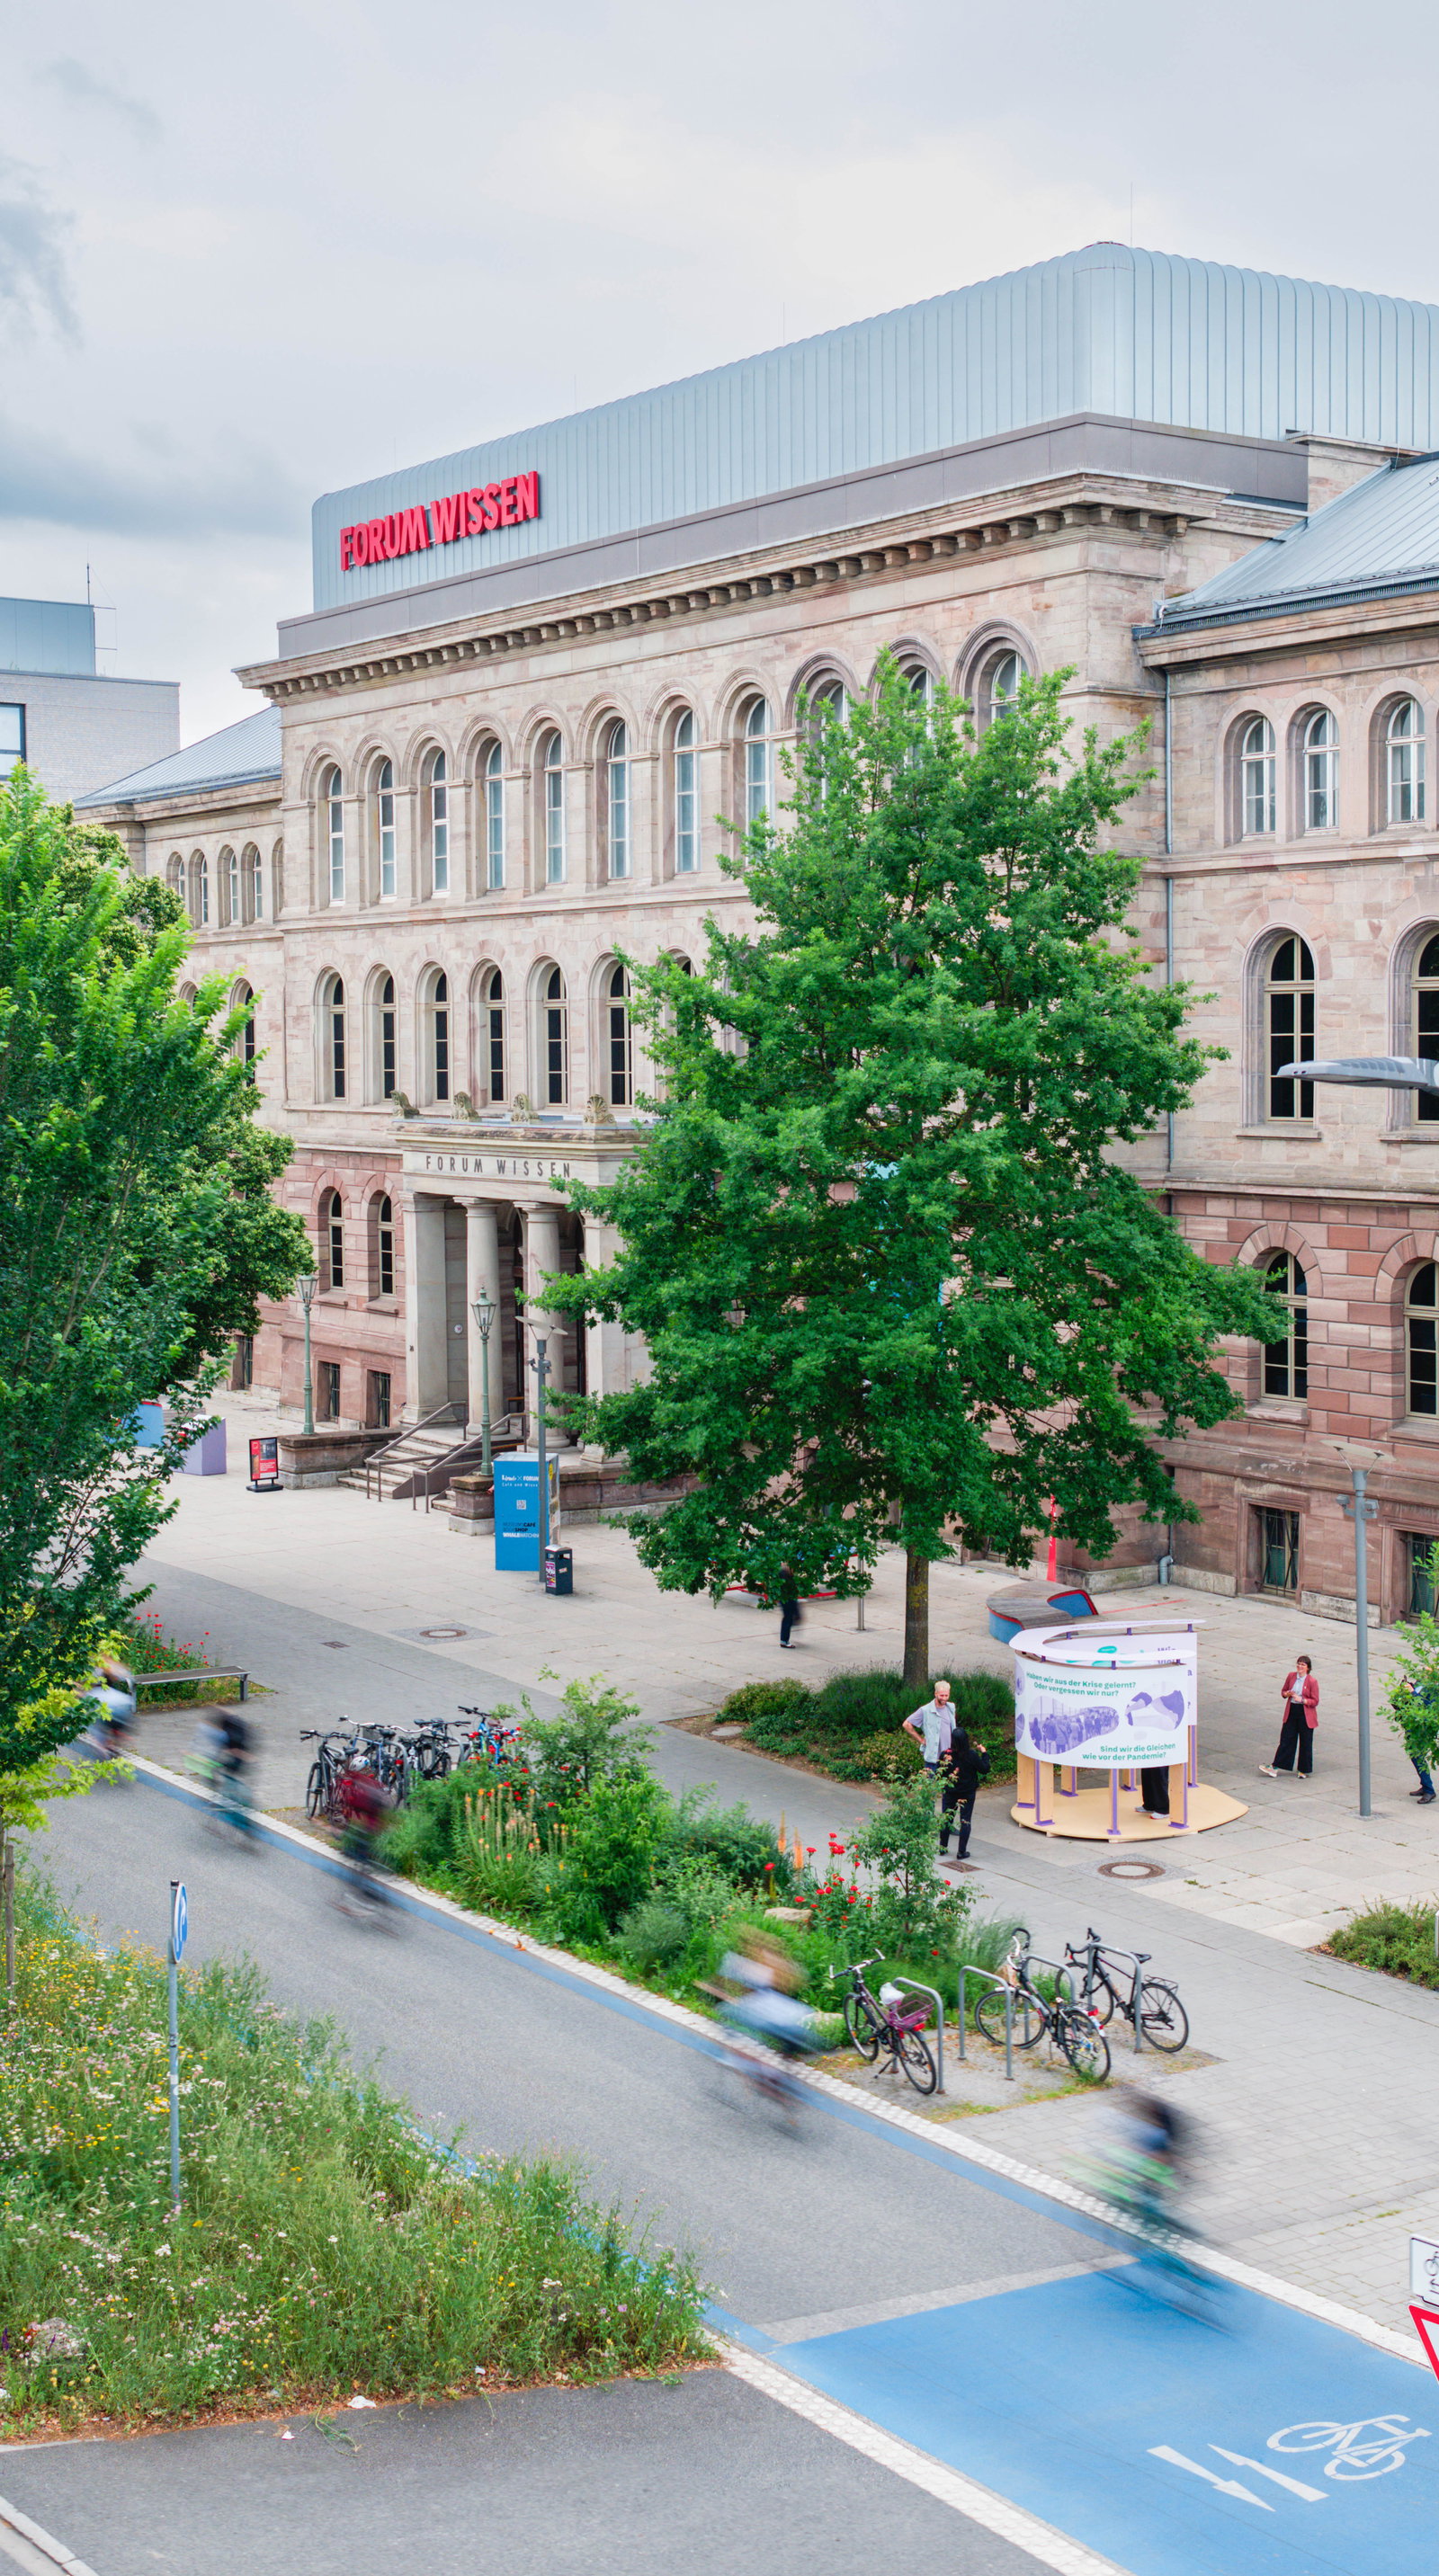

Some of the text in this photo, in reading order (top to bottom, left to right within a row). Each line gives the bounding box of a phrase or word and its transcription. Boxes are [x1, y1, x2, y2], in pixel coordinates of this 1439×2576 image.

[340, 471, 540, 571] FORUM WISSEN
[426, 1155, 570, 1178] FORUM WISSEN
[1026, 1671, 1042, 1680] Haben
[1104, 1681, 1136, 1689] gelernt?
[1033, 1681, 1048, 1690] Oder
[1049, 1685, 1086, 1695] vergessen
[1146, 1743, 1176, 1751] Gleichen
[1127, 1752, 1166, 1760] Pandemie?
